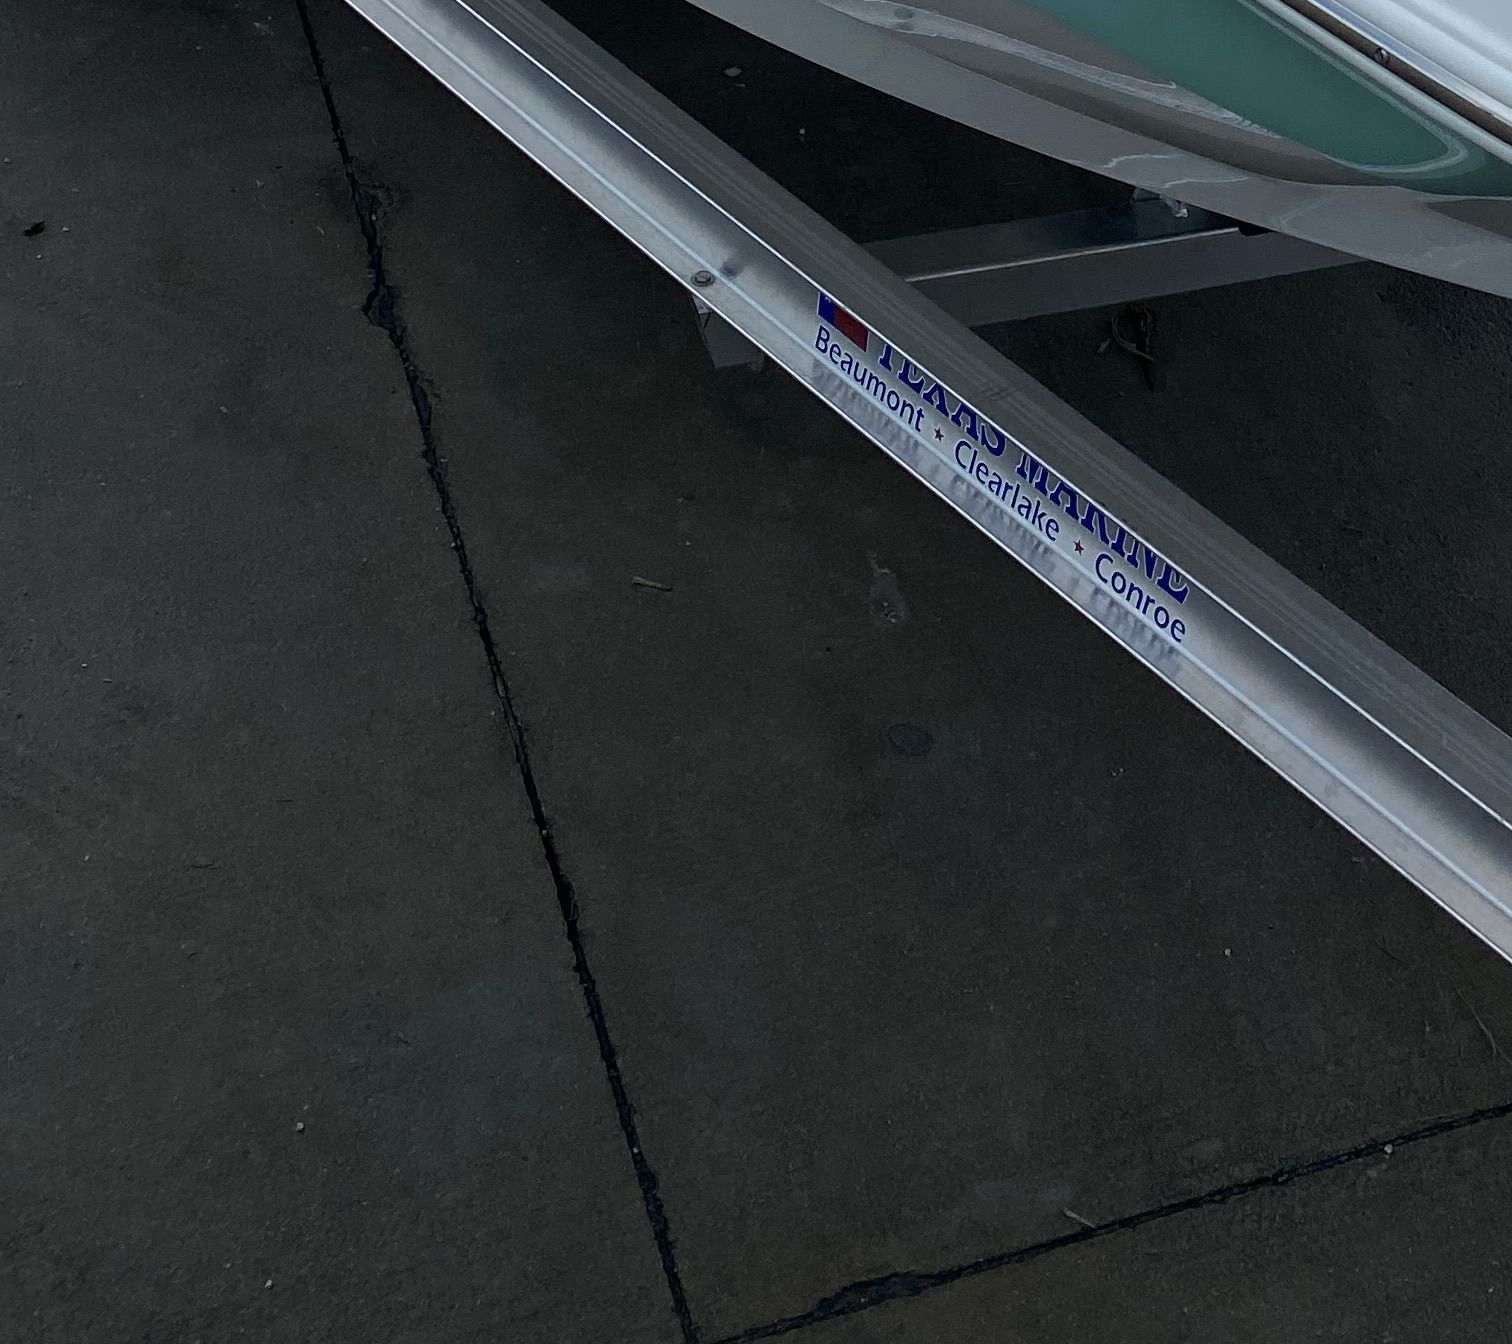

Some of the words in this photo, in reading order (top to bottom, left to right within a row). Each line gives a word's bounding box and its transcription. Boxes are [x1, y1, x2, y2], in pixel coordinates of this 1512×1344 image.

[814, 324, 925, 433] Beaumont
[954, 439, 1060, 542] Clearlake
[1094, 553, 1187, 644] Conroe
